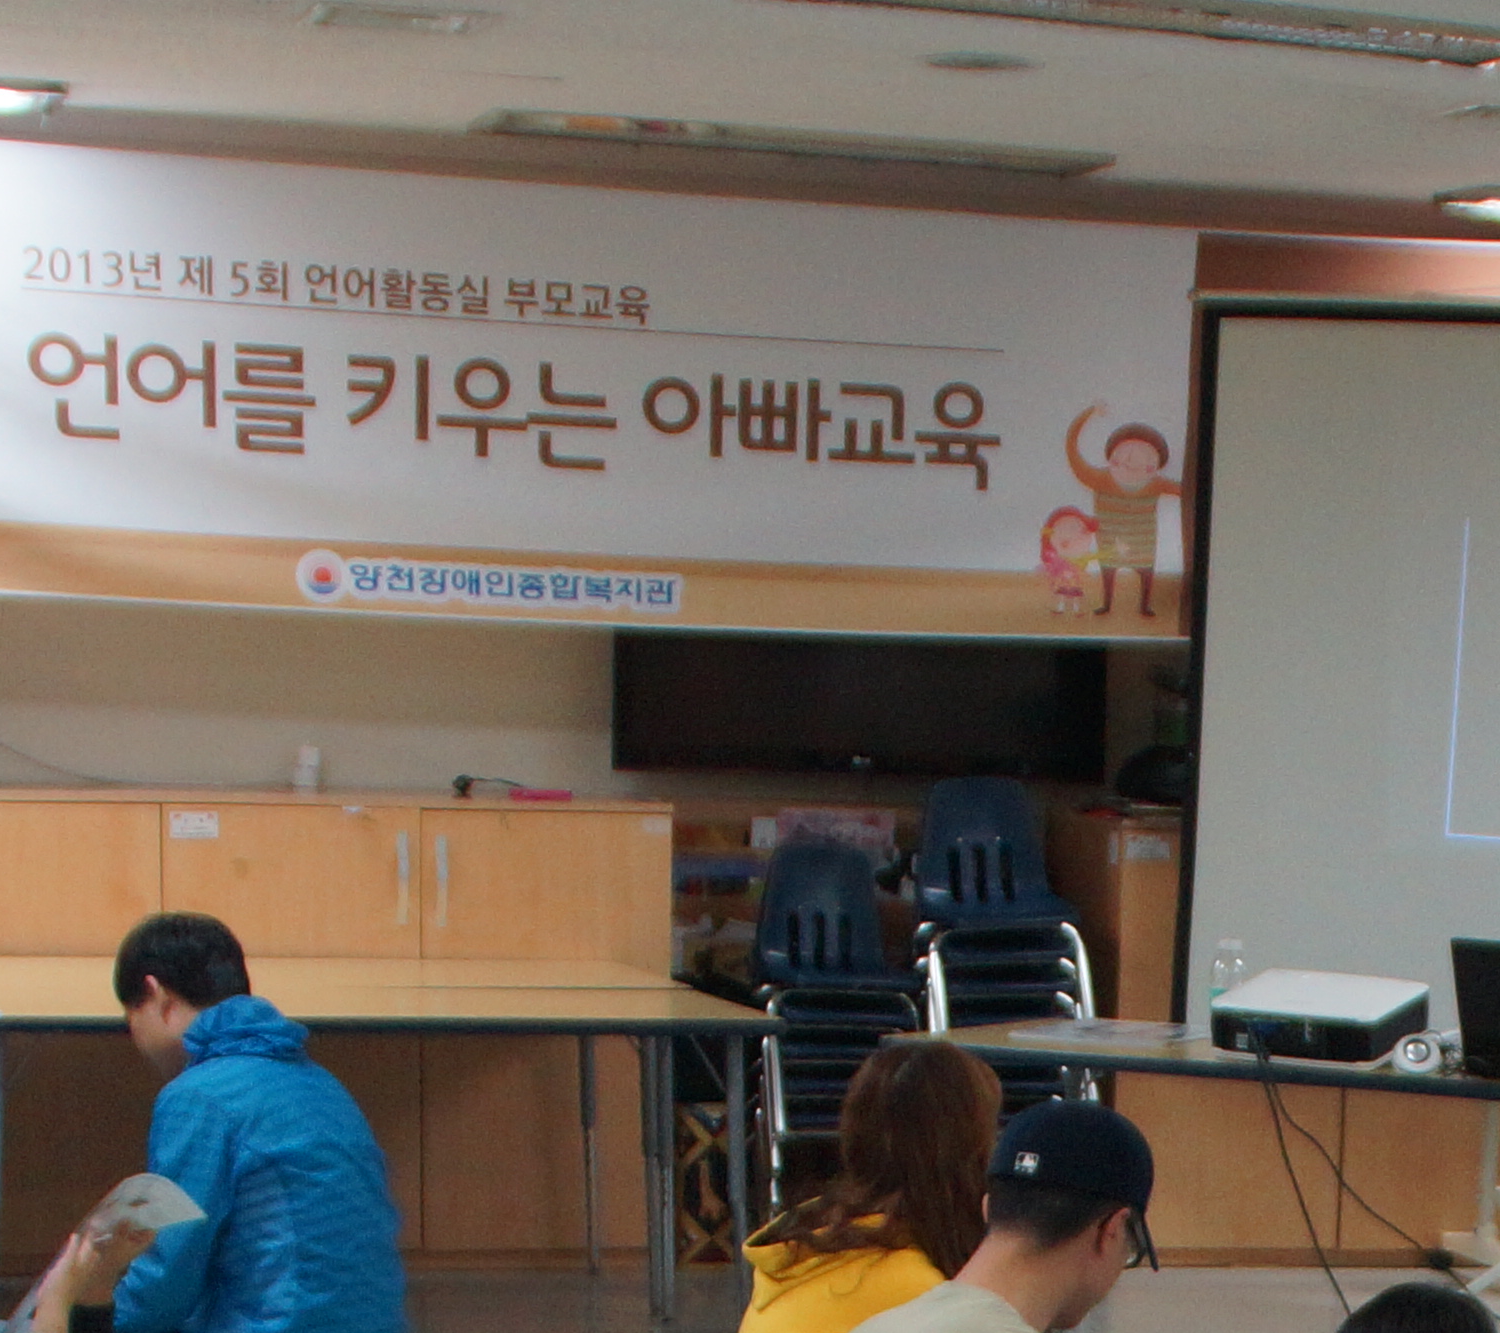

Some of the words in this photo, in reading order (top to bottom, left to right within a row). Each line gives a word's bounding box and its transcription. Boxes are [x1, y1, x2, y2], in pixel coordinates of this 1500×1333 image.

[21, 245, 162, 292] 2013년
[176, 255, 215, 296] 제
[229, 261, 291, 301] 5회
[304, 263, 491, 316] 언어활동실
[502, 276, 651, 326] 부모교육
[26, 332, 317, 457] 언어를
[346, 353, 618, 471] 키우는
[641, 372, 1002, 492] 아빠교육
[348, 562, 676, 607] 양천장애인종합복지관
